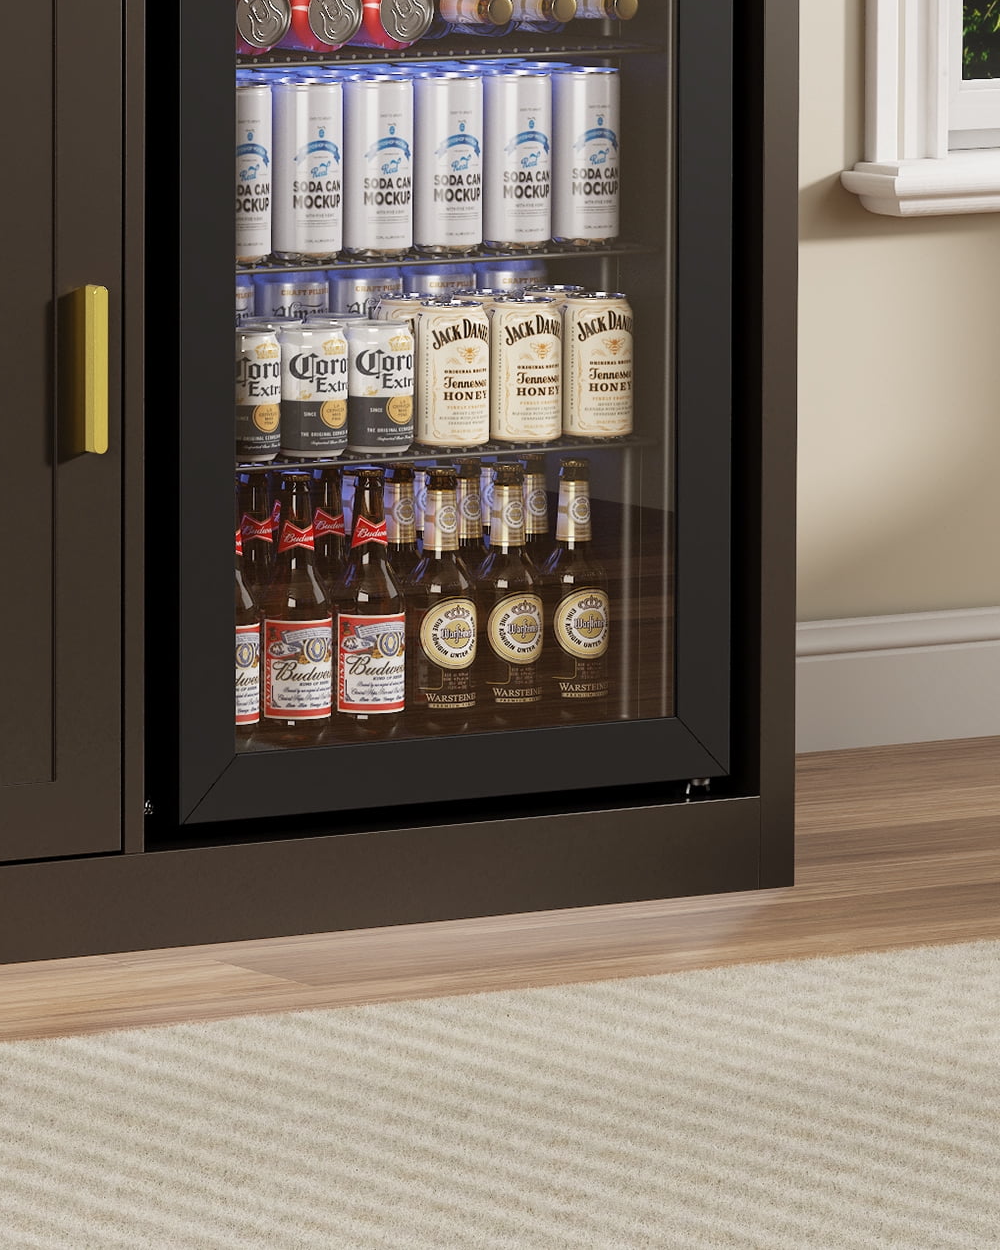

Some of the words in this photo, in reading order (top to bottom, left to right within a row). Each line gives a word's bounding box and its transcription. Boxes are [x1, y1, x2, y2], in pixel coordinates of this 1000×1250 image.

[434, 174, 464, 186] SODA
[466, 173, 481, 186] CAN
[503, 171, 533, 183] SODA
[535, 170, 550, 182] CAN
[572, 168, 602, 180] SODA
[604, 167, 618, 179] CAN
[254, 182, 270, 195] CAN
[293, 181, 324, 193] SODA
[326, 180, 341, 192] CAN
[364, 177, 394, 189] SODA
[396, 176, 411, 189] CAN
[572, 181, 618, 196] MOCKUP
[364, 190, 411, 205] MOCKUP
[434, 187, 480, 202] MOCKUP
[503, 184, 550, 199] MOCKUP
[236, 198, 270, 212] OCKUP
[293, 194, 341, 209] MOCKUP
[281, 289, 307, 297] CRAFT
[355, 285, 381, 293] CRAFT
[504, 321, 535, 346] JACK
[577, 316, 607, 342] JACK
[432, 324, 462, 350] JACK
[516, 386, 560, 396] HONEY
[589, 381, 632, 392] HONEY
[443, 390, 487, 401] HONEY
